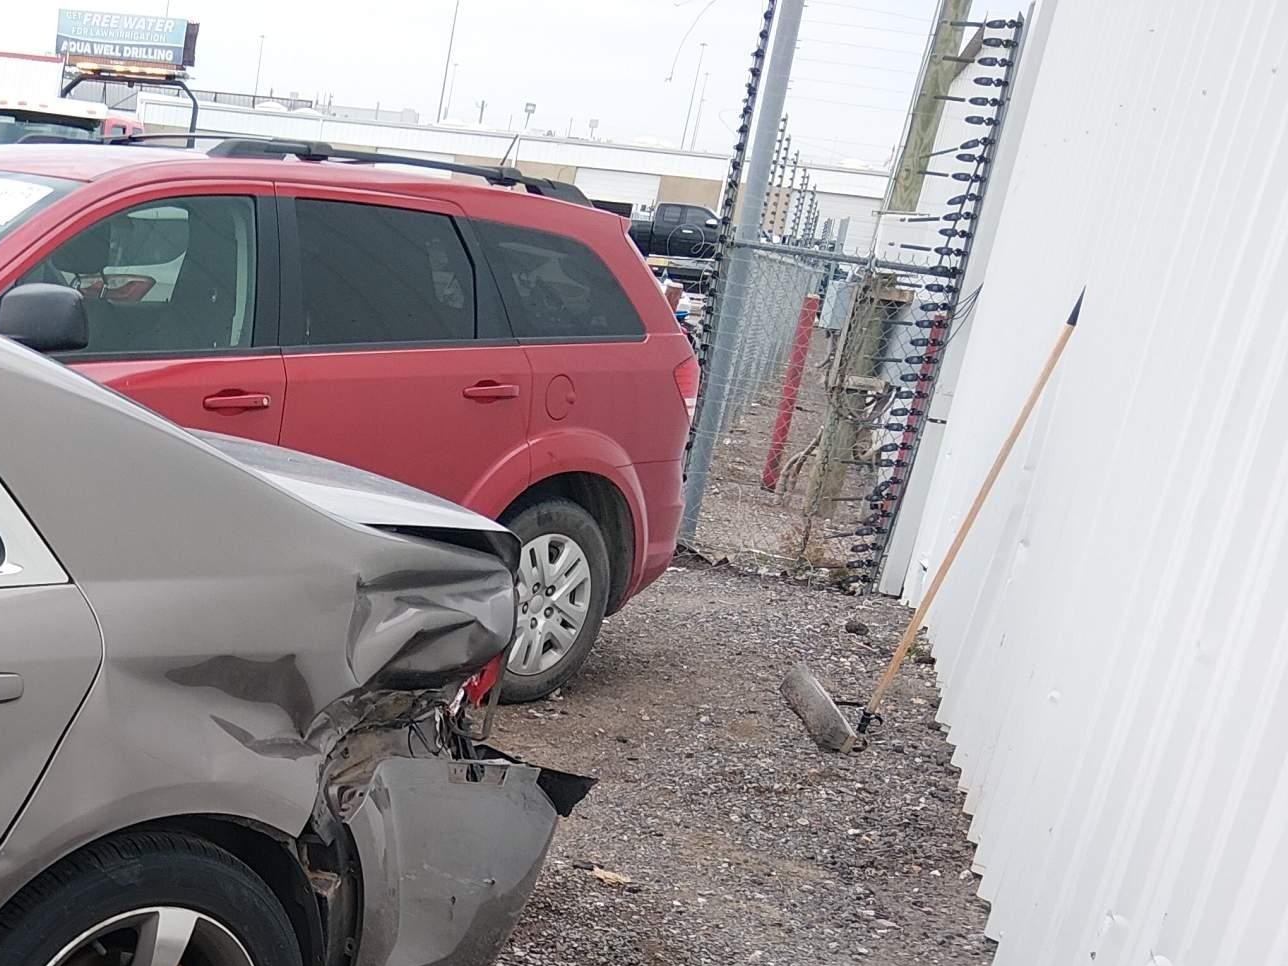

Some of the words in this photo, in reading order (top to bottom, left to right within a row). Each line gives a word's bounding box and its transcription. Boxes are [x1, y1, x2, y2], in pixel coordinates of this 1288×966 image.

[83, 13, 119, 29] FREE
[123, 16, 175, 33] WATER
[71, 26, 88, 36] FOR
[90, 28, 114, 39] LAWN
[116, 31, 166, 43] IRRIGATION
[61, 41, 92, 53] AQUA
[93, 43, 122, 57] WELL
[123, 46, 173, 60] DRILLING
